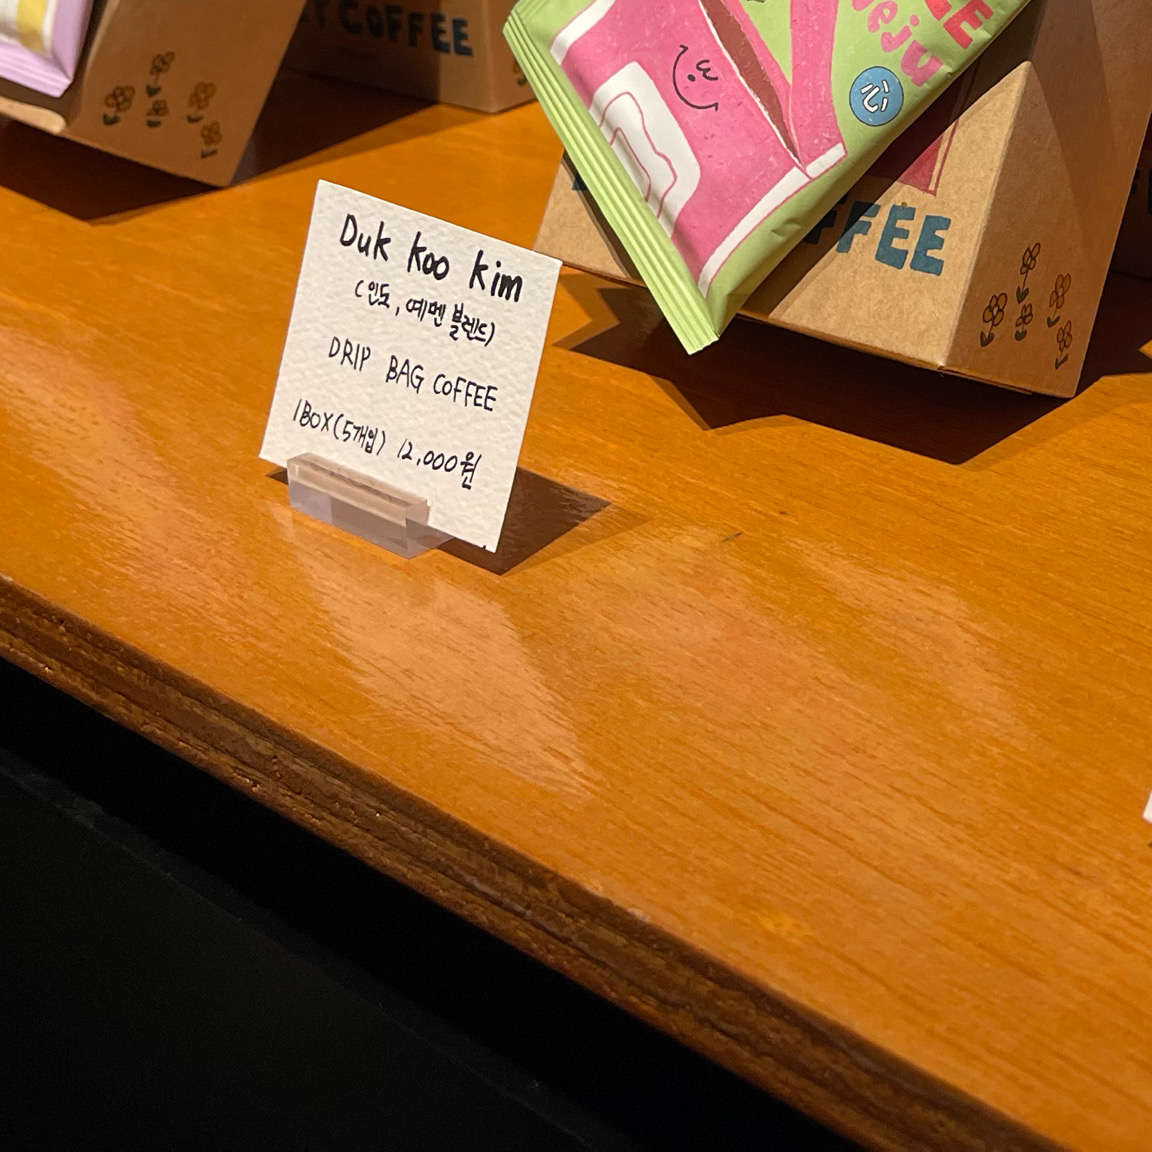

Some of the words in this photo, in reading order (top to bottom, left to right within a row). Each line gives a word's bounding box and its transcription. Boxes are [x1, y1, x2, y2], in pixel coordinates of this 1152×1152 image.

[340, 214, 391, 262] Duk
[405, 298, 446, 326] 예멘
[328, 336, 371, 371] DRIP
[386, 355, 424, 394] BAG
[433, 374, 498, 411] COFFEE
[397, 439, 482, 490] 12,000원
